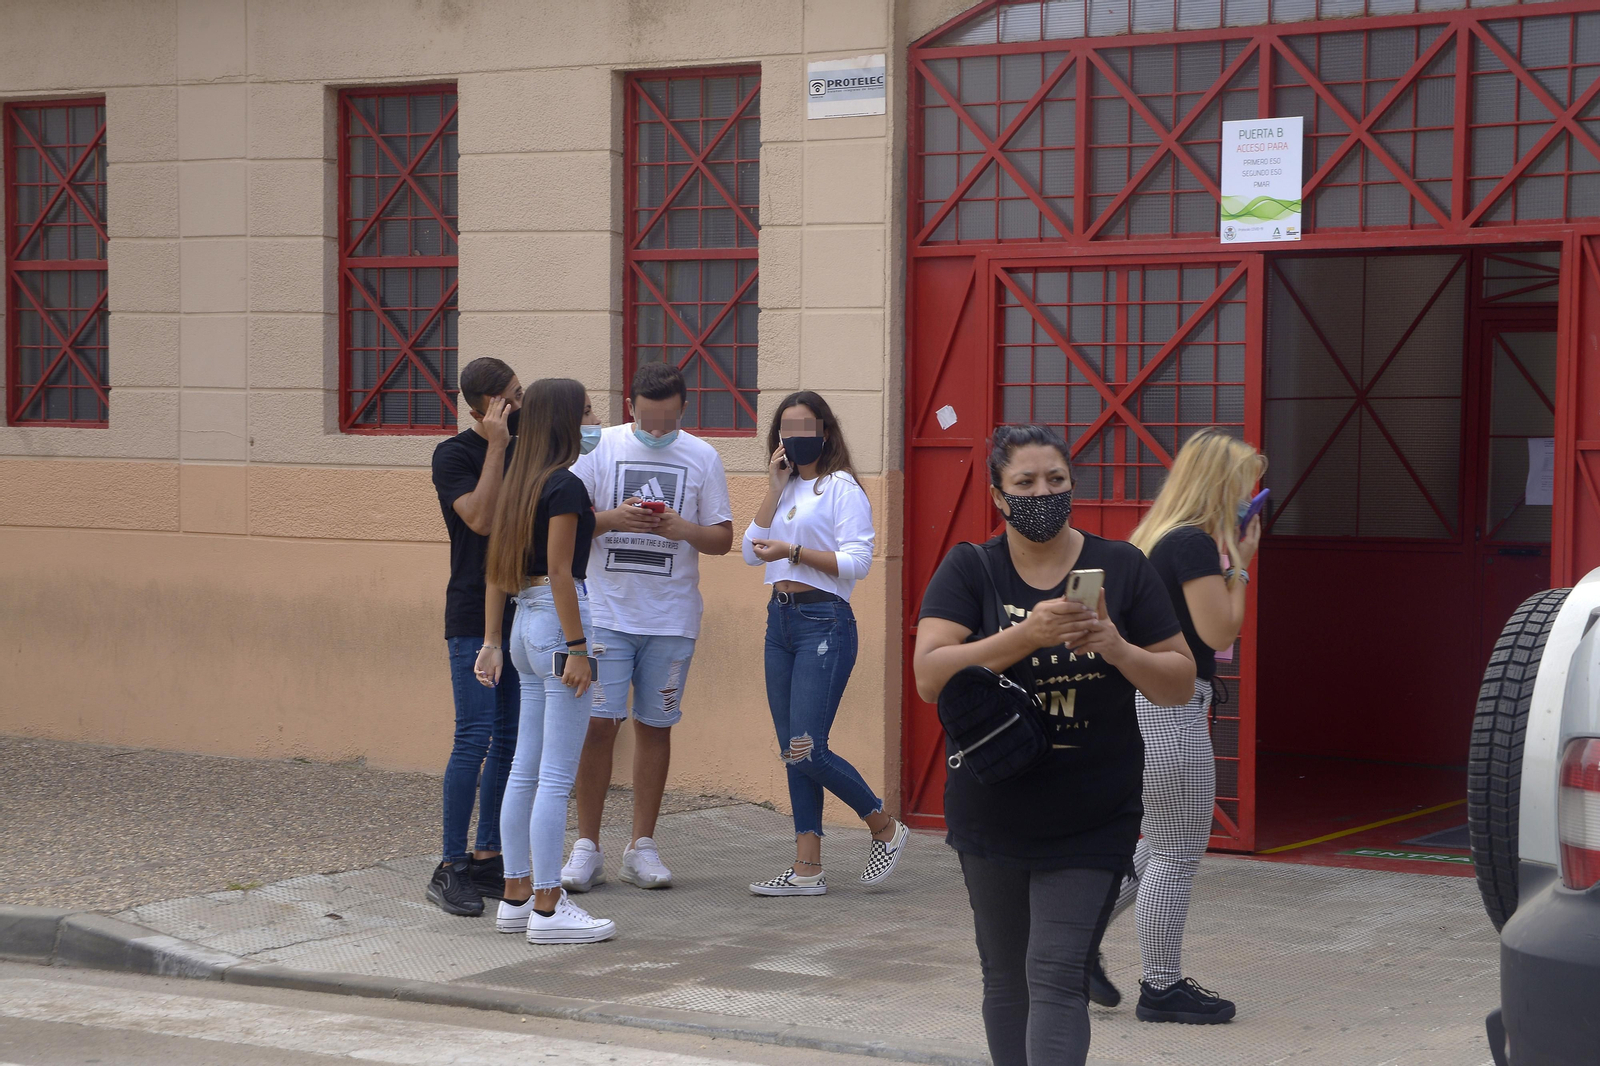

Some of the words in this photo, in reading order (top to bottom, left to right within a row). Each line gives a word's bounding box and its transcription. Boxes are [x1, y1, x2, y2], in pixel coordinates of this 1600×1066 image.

[827, 76, 884, 88] PROTELEC
[1238, 128, 1274, 140] PUERTA
[1276, 127, 1284, 138] B
[1236, 143, 1265, 153] ACCESO
[1267, 142, 1289, 151] PARA
[1243, 158, 1268, 166] PRIMERO
[1269, 157, 1282, 165] ESO
[1242, 169, 1269, 177] SEGUNDO
[1270, 168, 1282, 176] ESO
[605, 536, 613, 544] THE
[613, 536, 629, 544] BRAND
[630, 537, 645, 546] WITH
[646, 538, 657, 547] THE
[661, 540, 679, 550] STRIPES
